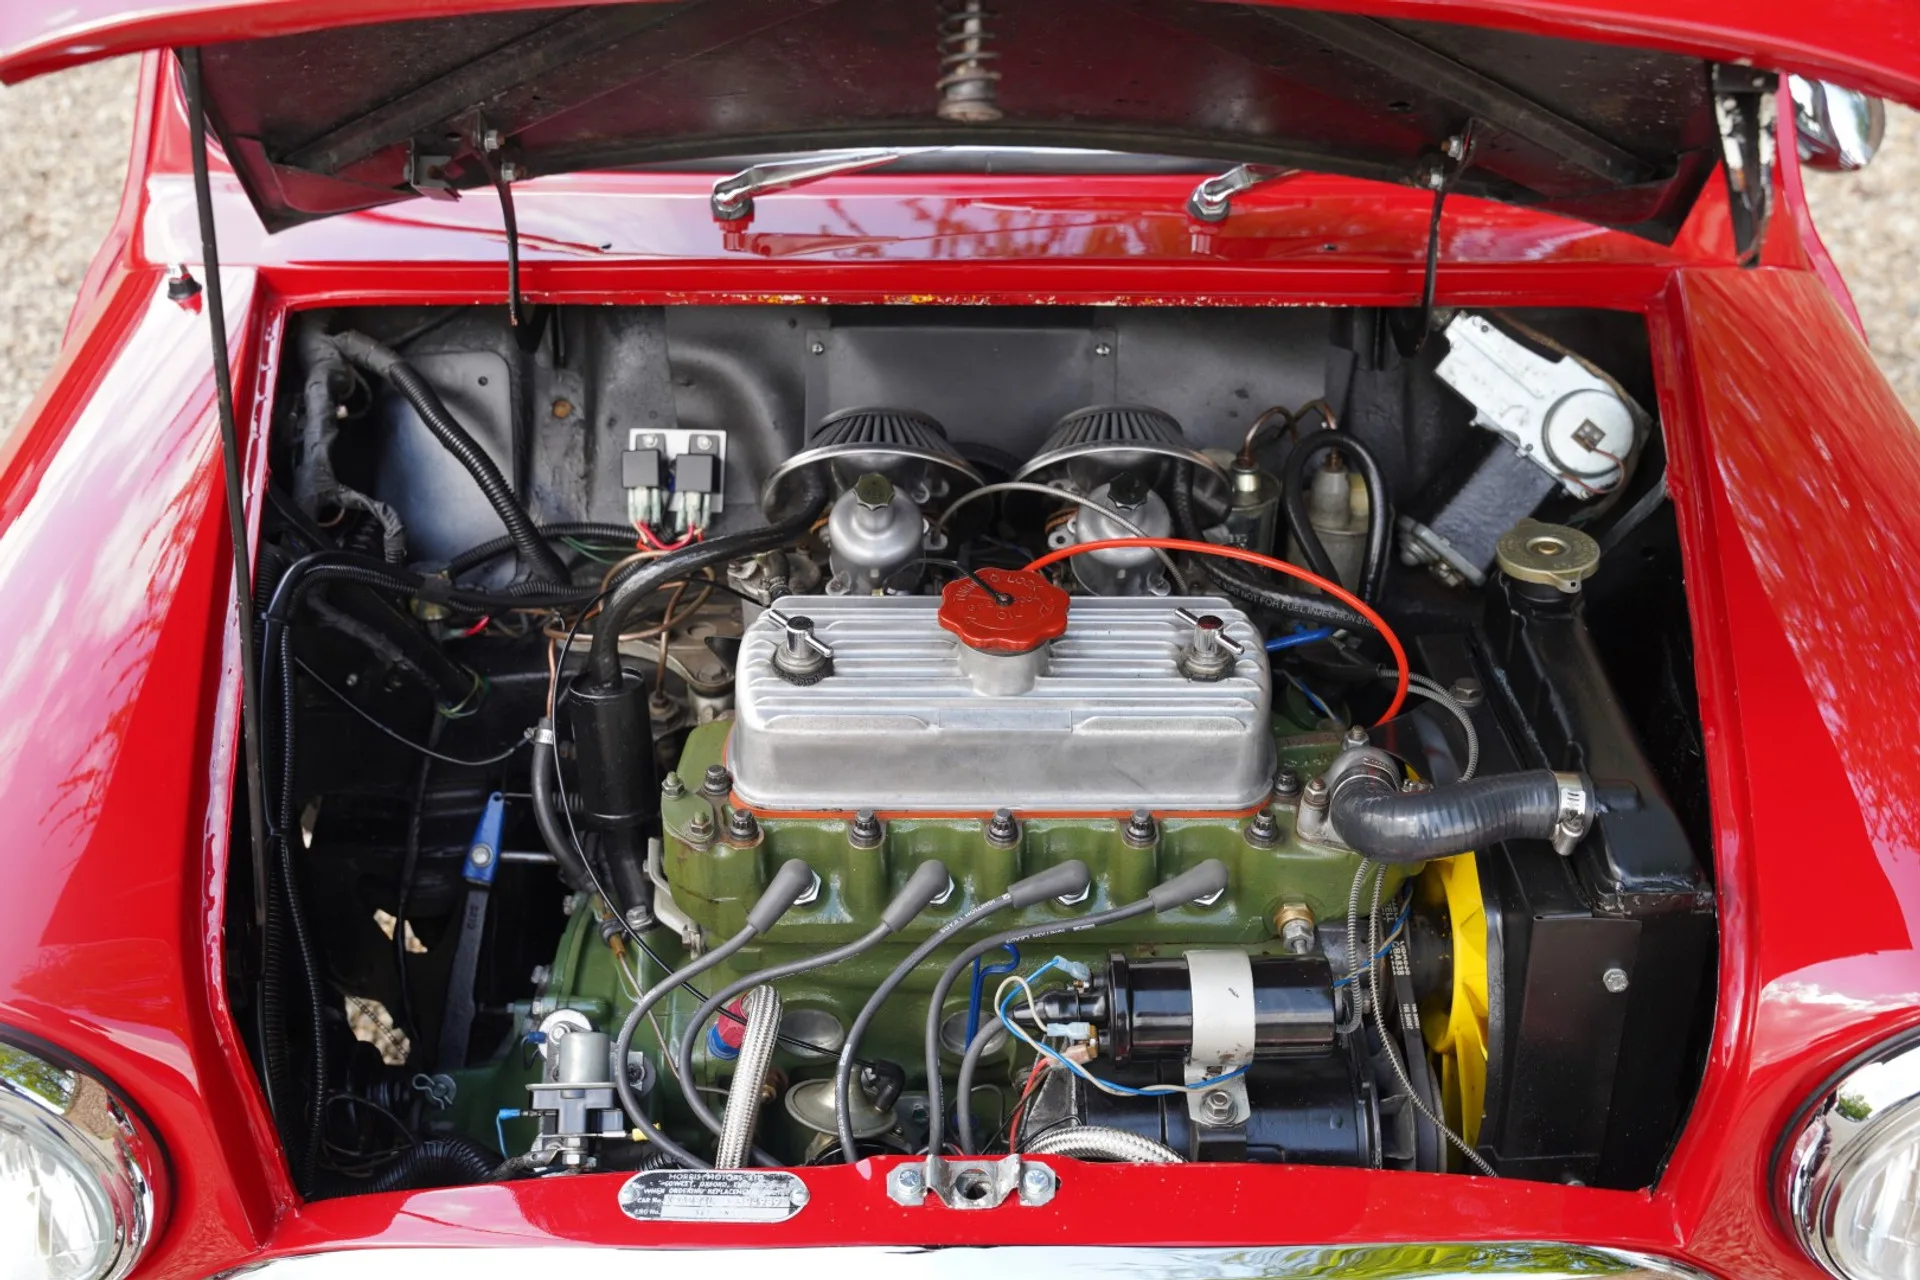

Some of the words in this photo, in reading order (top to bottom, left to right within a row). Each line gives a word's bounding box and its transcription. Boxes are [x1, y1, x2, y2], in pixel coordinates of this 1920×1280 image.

[1007, 574, 1044, 592] LOCK
[997, 611, 1023, 620] OIL
[1260, 596, 1279, 608] FOR
[1281, 602, 1306, 614] FUEL
[1307, 605, 1356, 622] INJECTION
[668, 1172, 700, 1181] MORRIS
